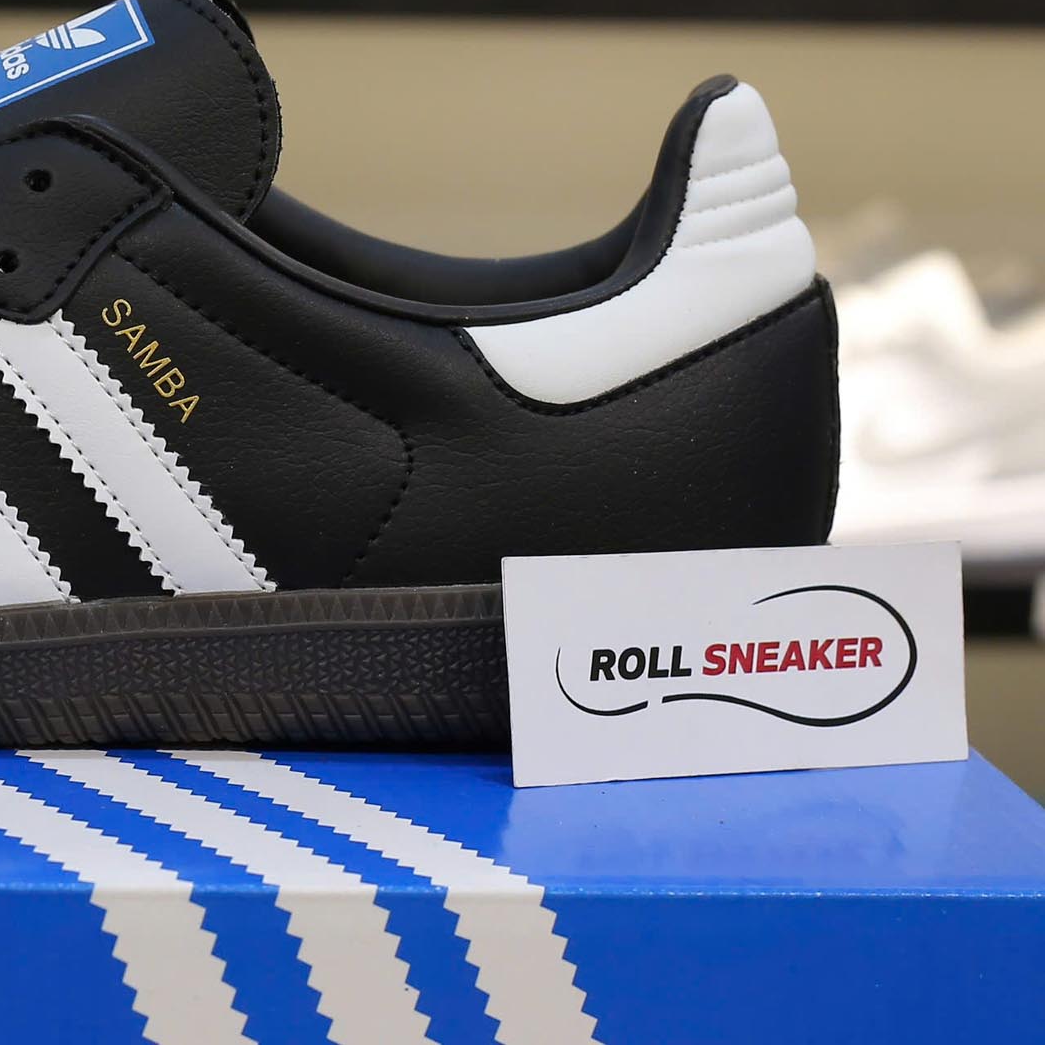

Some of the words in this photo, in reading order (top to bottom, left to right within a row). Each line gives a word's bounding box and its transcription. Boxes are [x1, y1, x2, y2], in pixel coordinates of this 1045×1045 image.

[102, 298, 200, 424] SAMBA
[589, 645, 692, 682] ROLL
[702, 636, 883, 676] SNEAKER
